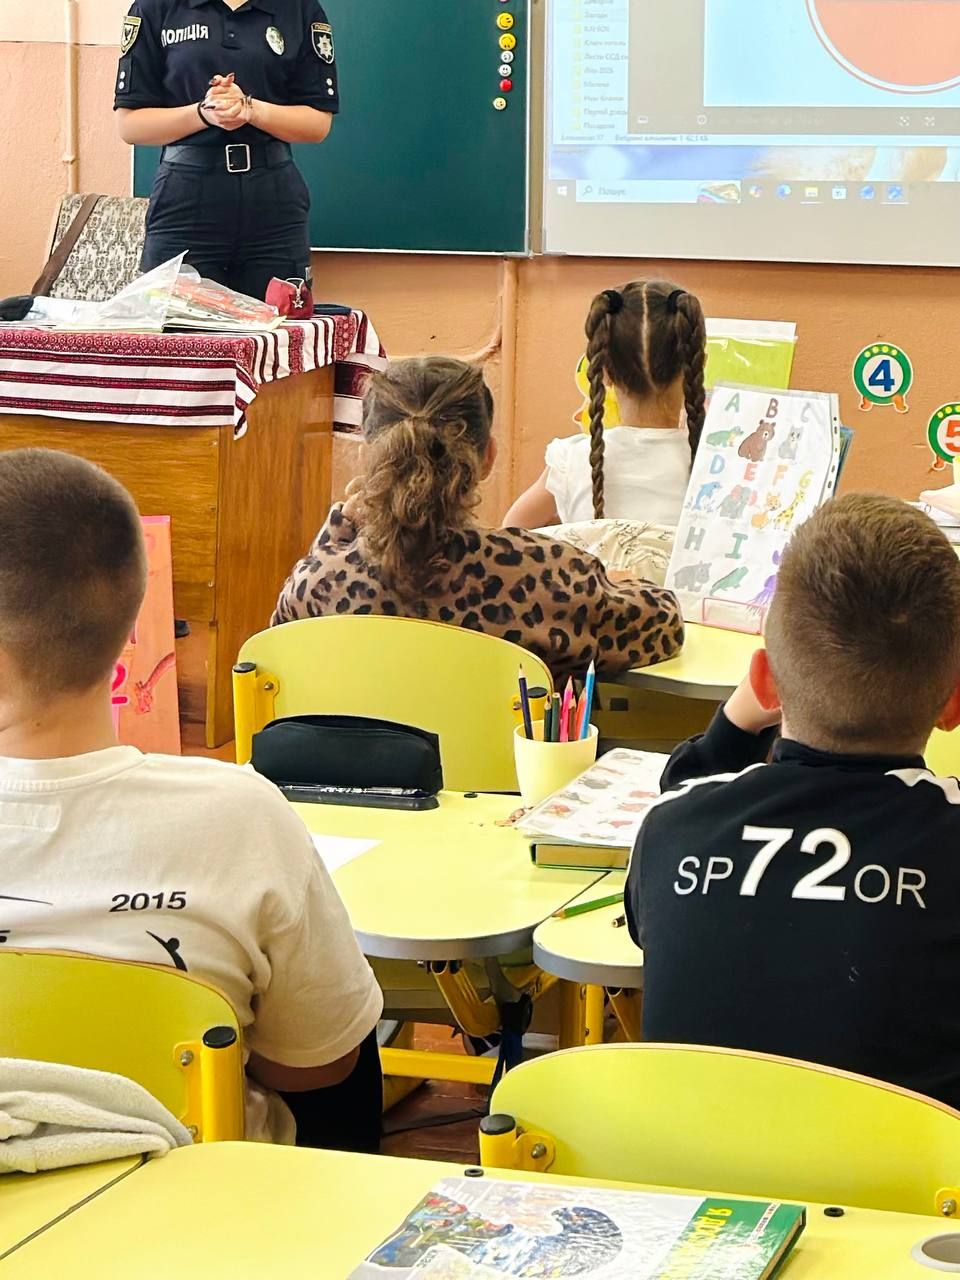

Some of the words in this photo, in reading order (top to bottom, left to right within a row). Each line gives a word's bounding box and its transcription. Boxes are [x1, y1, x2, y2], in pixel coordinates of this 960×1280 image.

[161, 24, 209, 48] ПОЛІЦІЯ
[868, 359, 895, 392] 4
[722, 392, 741, 413] A
[766, 397, 780, 419] B
[709, 454, 726, 475] D
[744, 463, 759, 481] E
[773, 465, 789, 487] F
[683, 526, 706, 552] H
[724, 532, 748, 560] I
[108, 891, 187, 913] 2015
